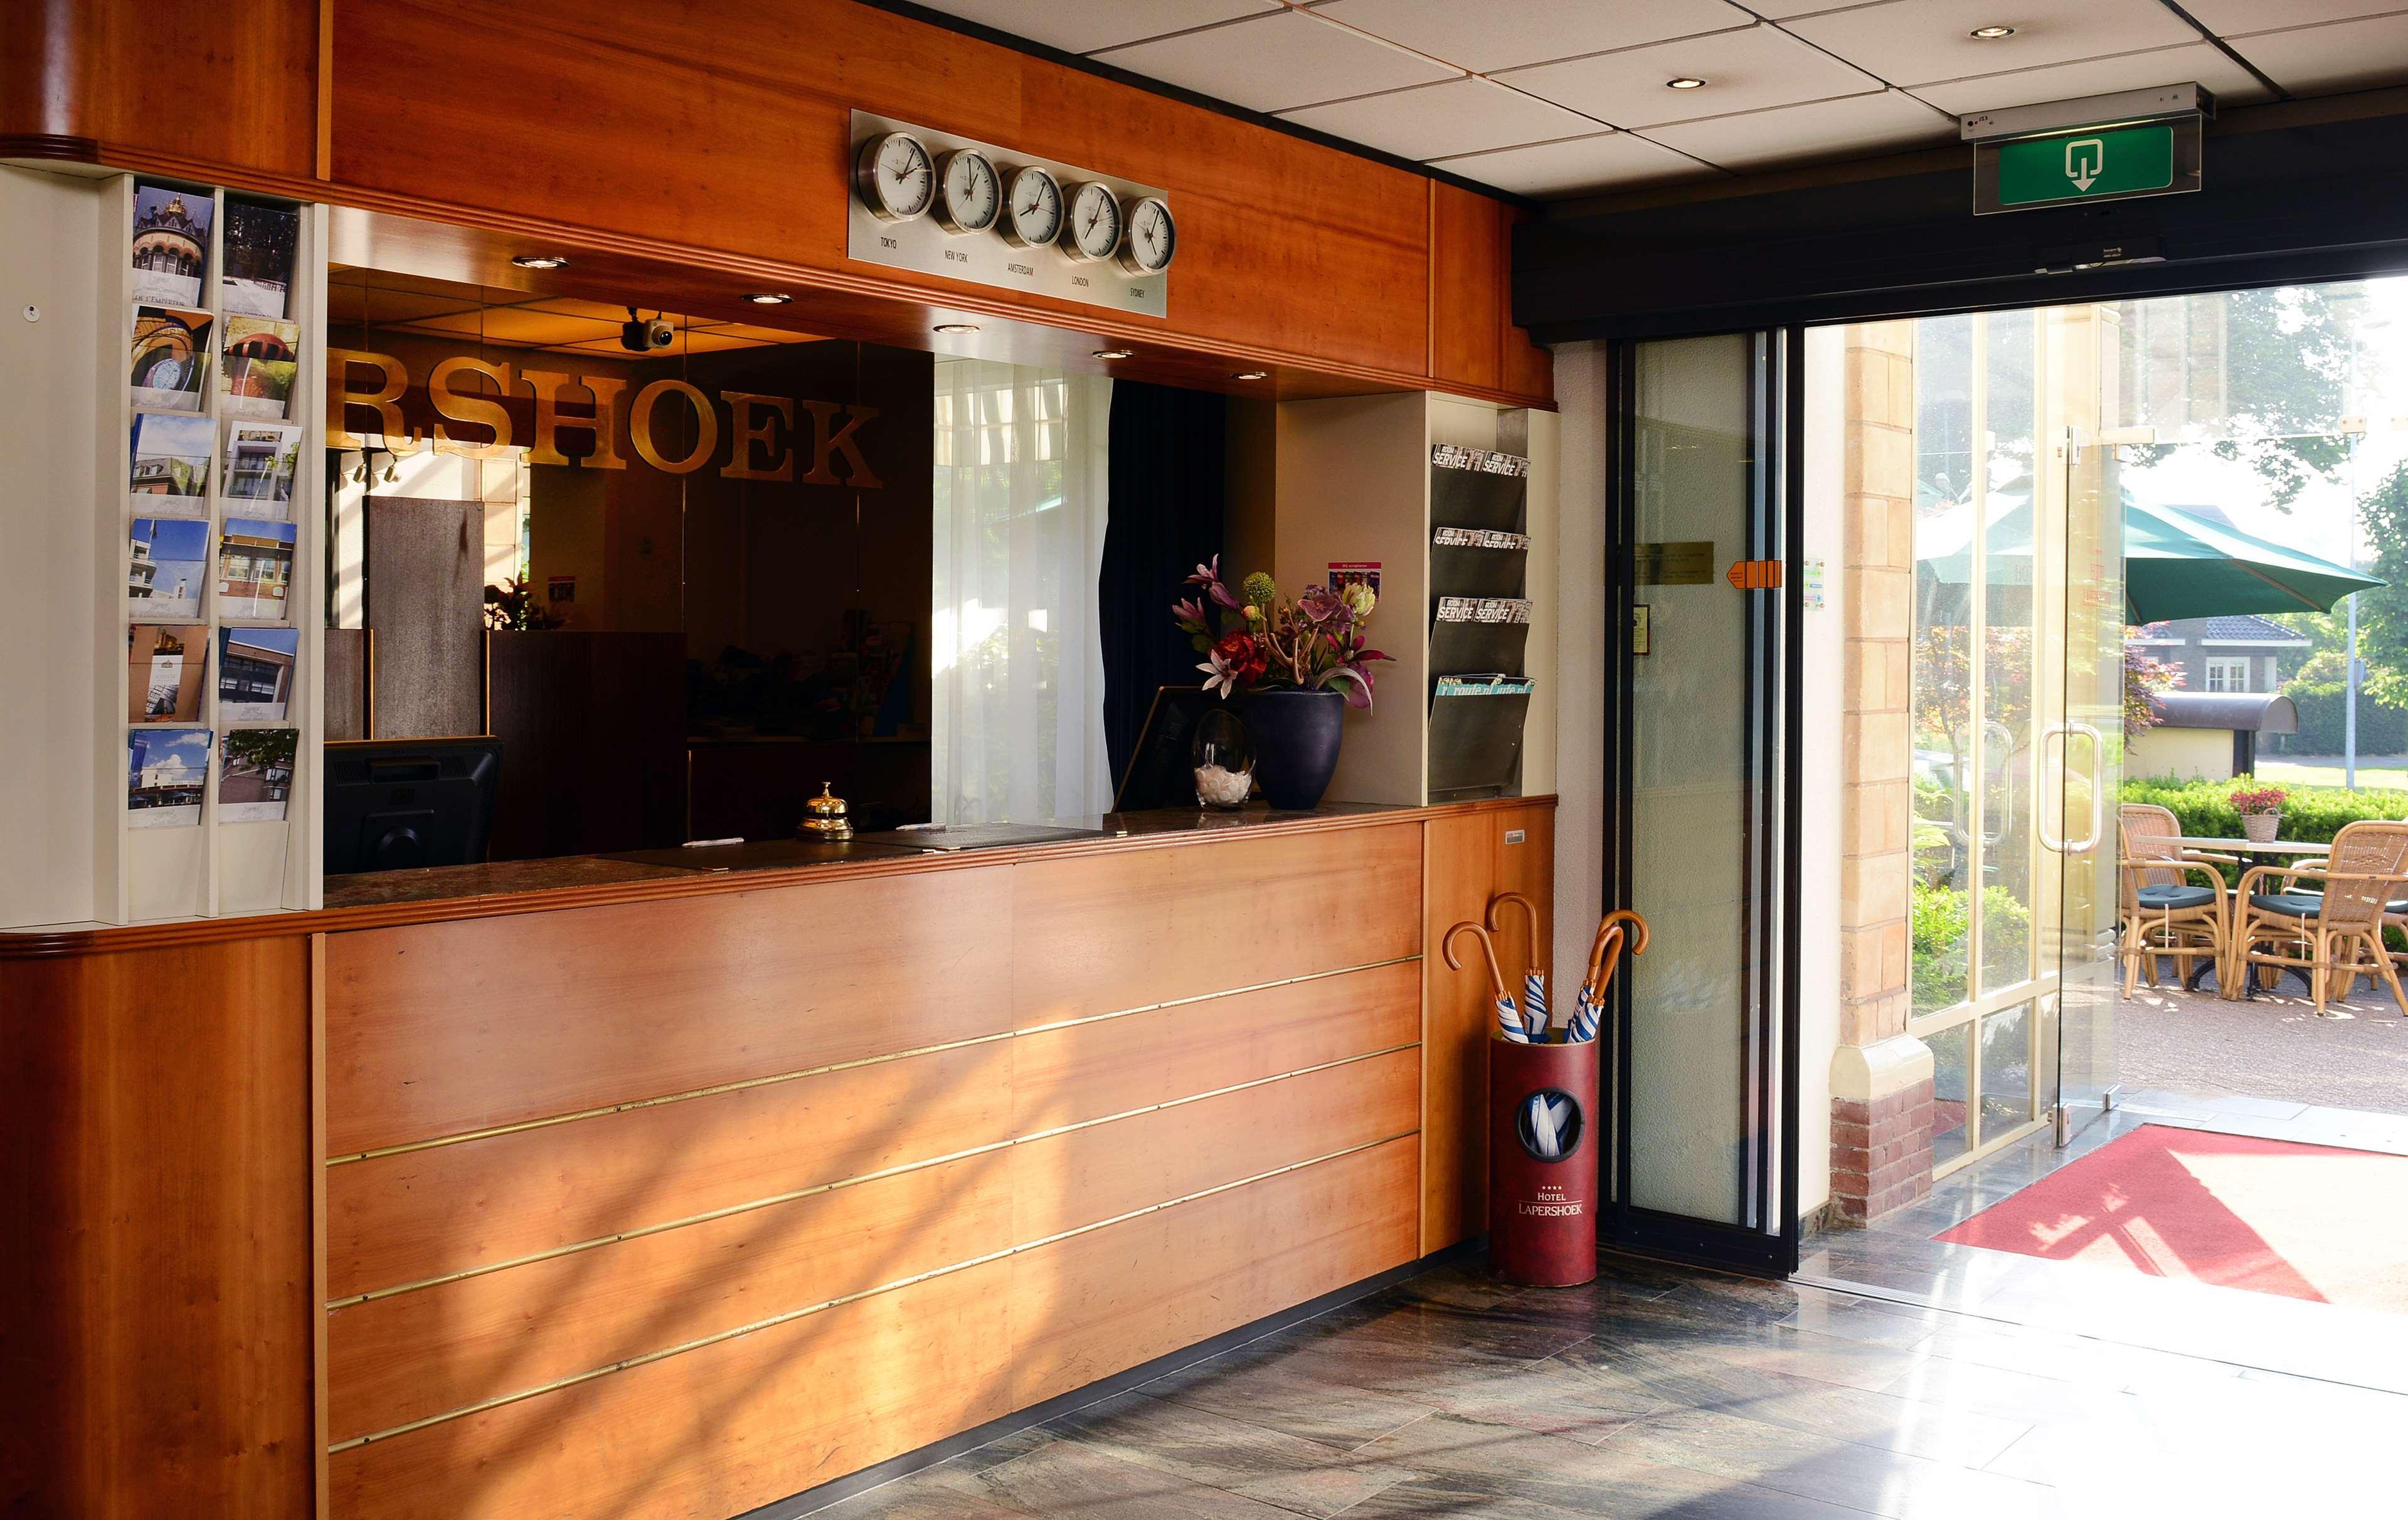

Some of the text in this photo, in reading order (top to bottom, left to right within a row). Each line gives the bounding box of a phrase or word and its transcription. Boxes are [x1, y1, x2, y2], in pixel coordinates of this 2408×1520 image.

[880, 237, 897, 249] TOKYO
[945, 250, 968, 263] NEW YORK
[1007, 263, 1034, 276] AMSTERDAM
[1071, 275, 1089, 288] LONDON
[1130, 287, 1144, 298] SYDNEY
[1433, 452, 1468, 468] SERVICE
[1483, 460, 1515, 476] SERVICE
[1438, 606, 1473, 619] SERVICE
[1476, 608, 1510, 620] SERVICE
[1537, 1193, 1566, 1201] HOTEL
[1519, 1203, 1583, 1216] LAPERSHOEK
